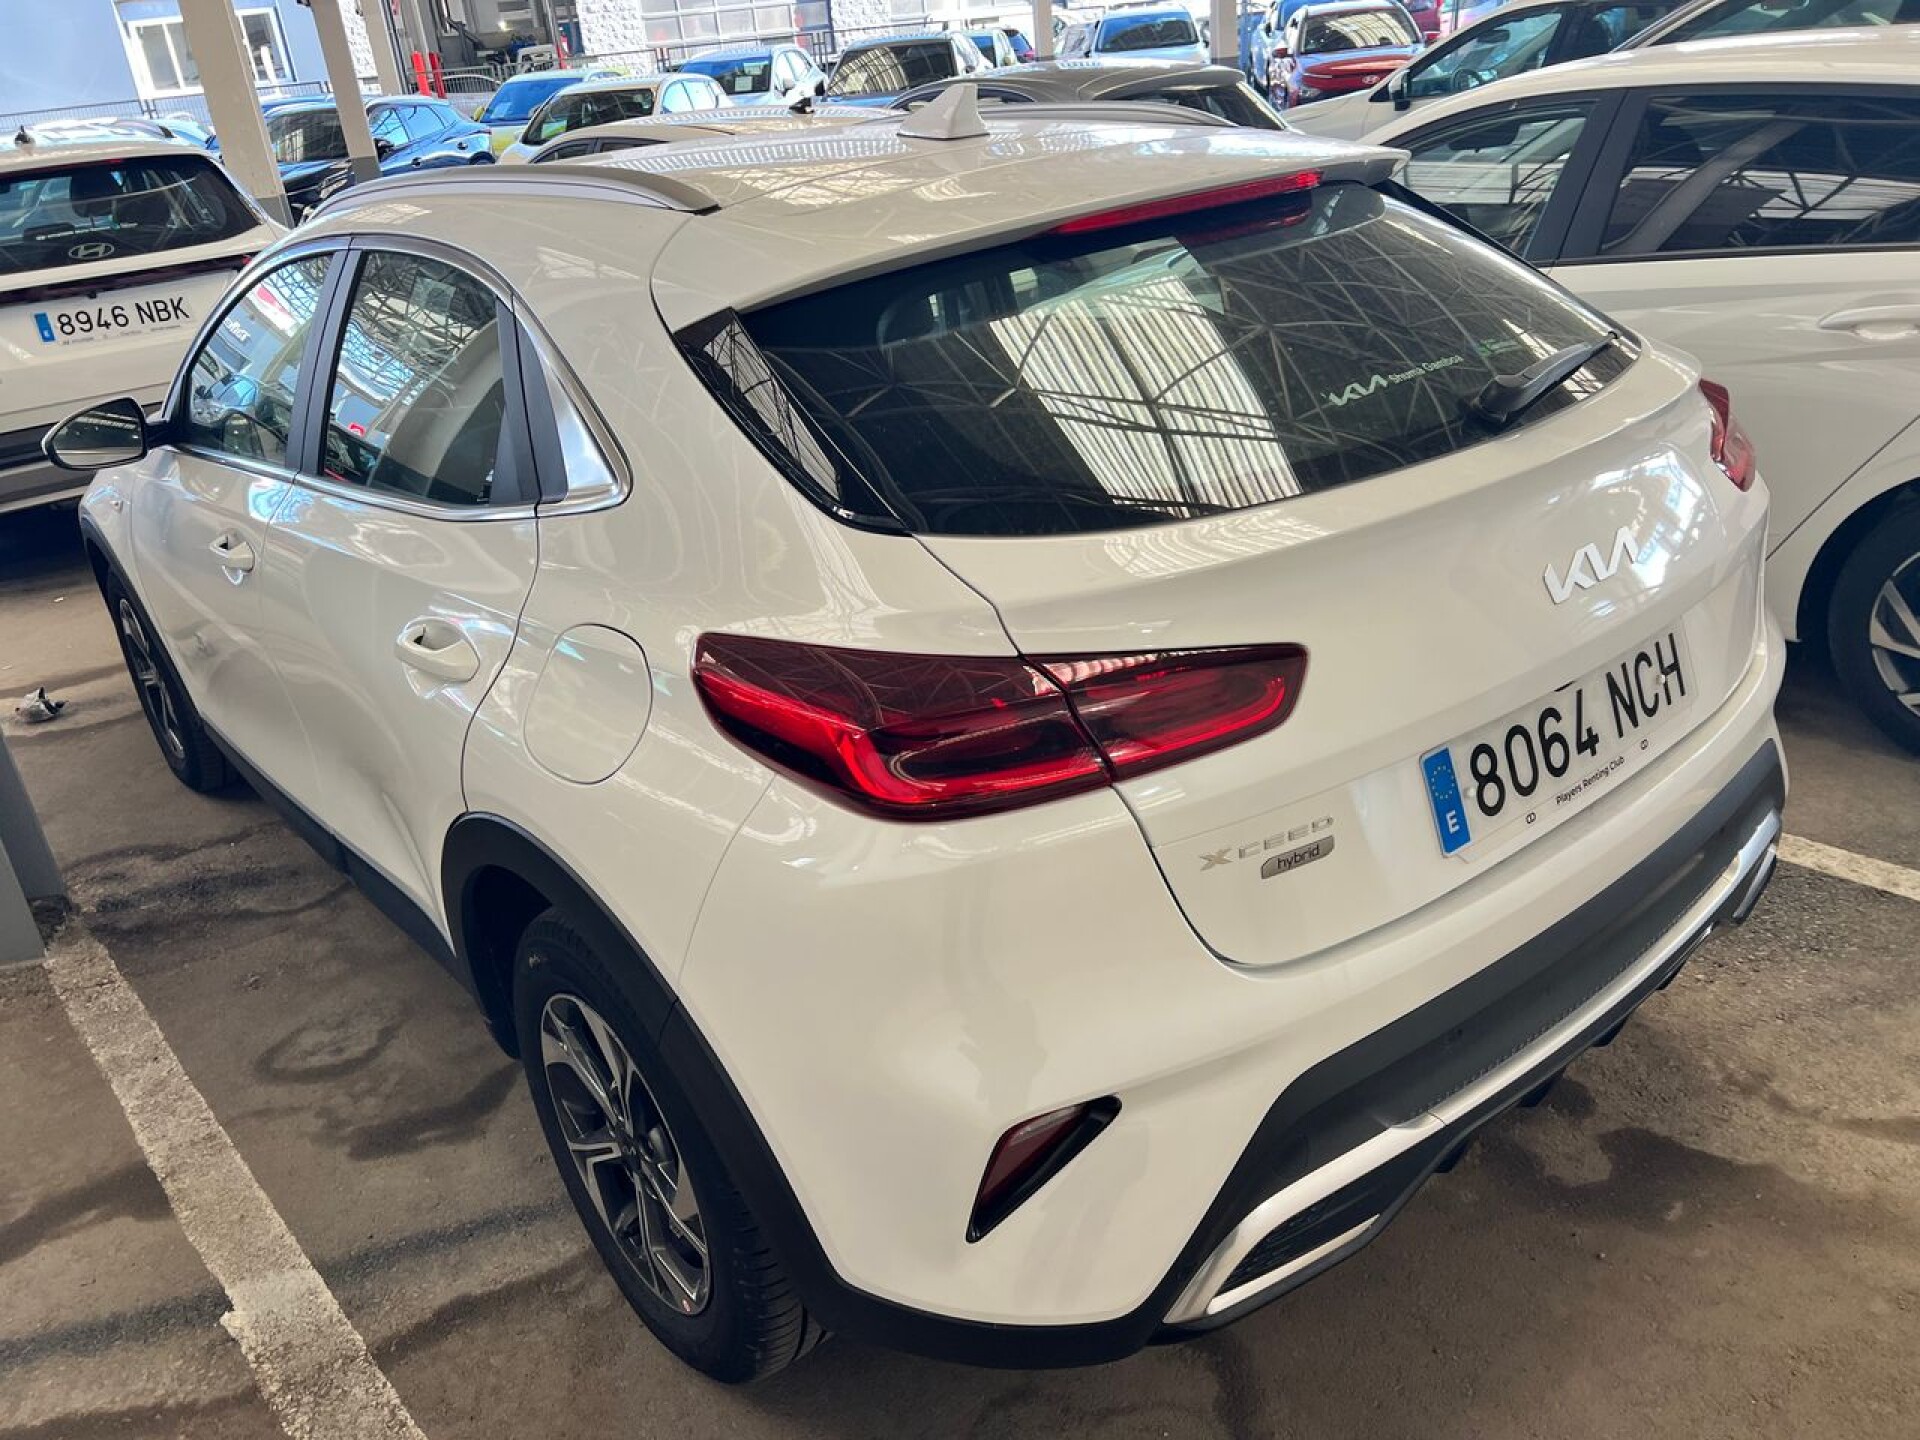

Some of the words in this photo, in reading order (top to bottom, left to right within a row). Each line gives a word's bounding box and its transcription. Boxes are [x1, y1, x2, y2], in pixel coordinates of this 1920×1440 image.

[57, 305, 129, 336] 8946
[135, 296, 190, 325] NBK
[1542, 526, 1640, 605] KIA
[1469, 688, 1600, 817] 8064
[1605, 632, 1687, 738] NCH
[1555, 784, 1583, 806] Players
[1582, 766, 1610, 788] Renting
[1609, 755, 1626, 772] Club
[1445, 809, 1461, 834] E
[1276, 843, 1321, 870] hybrid
